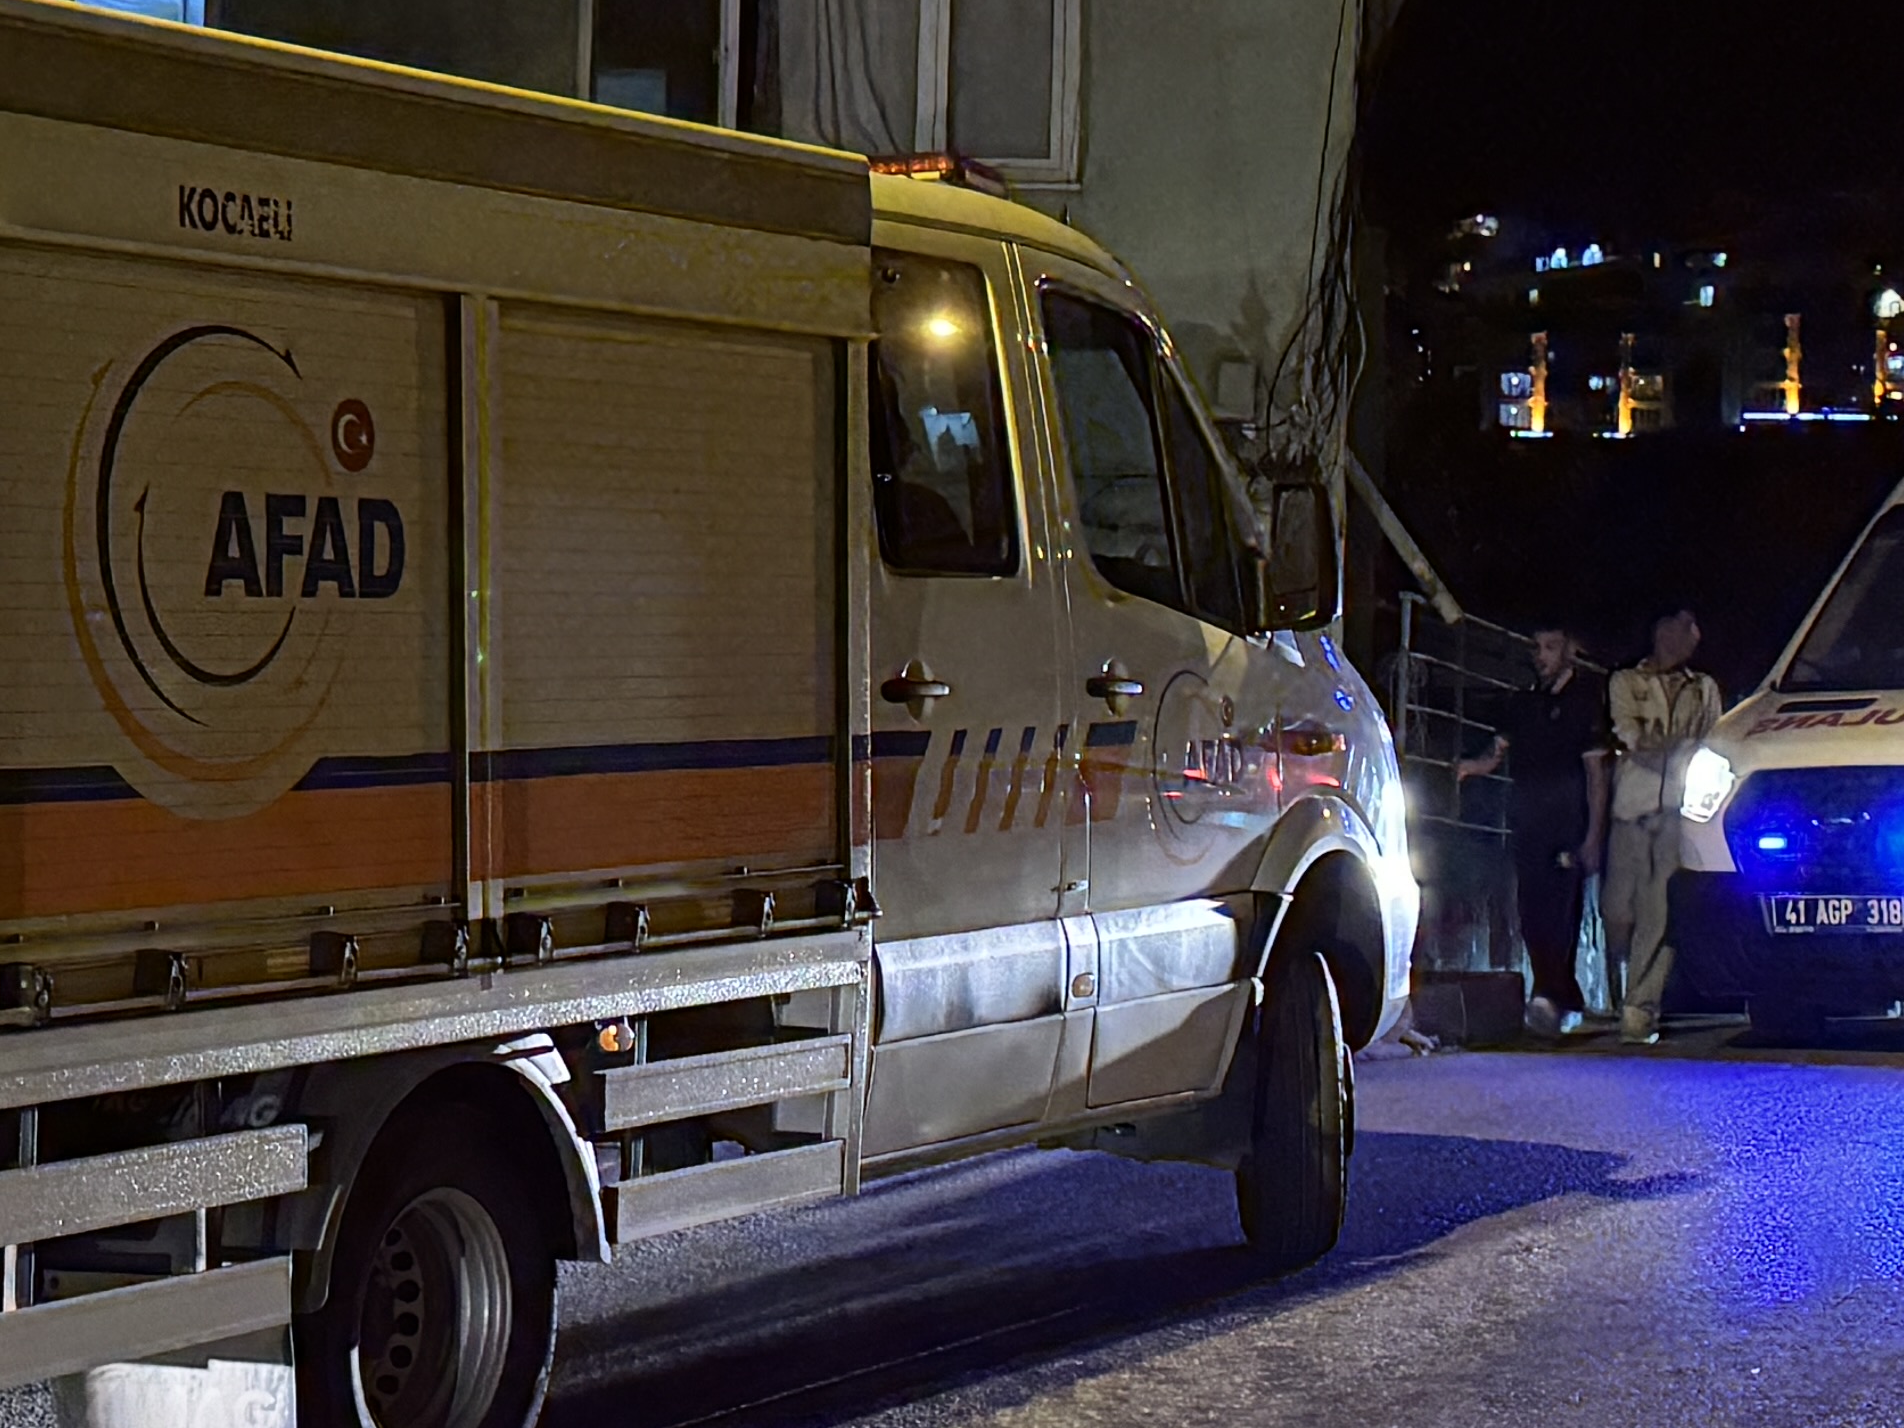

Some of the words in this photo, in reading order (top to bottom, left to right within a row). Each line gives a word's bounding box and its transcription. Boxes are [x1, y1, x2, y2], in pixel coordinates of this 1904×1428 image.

[204, 490, 406, 599] AFAD
[1785, 899, 1805, 925] 41
[1816, 899, 1853, 925] AGP
[1867, 899, 1902, 925] 318
